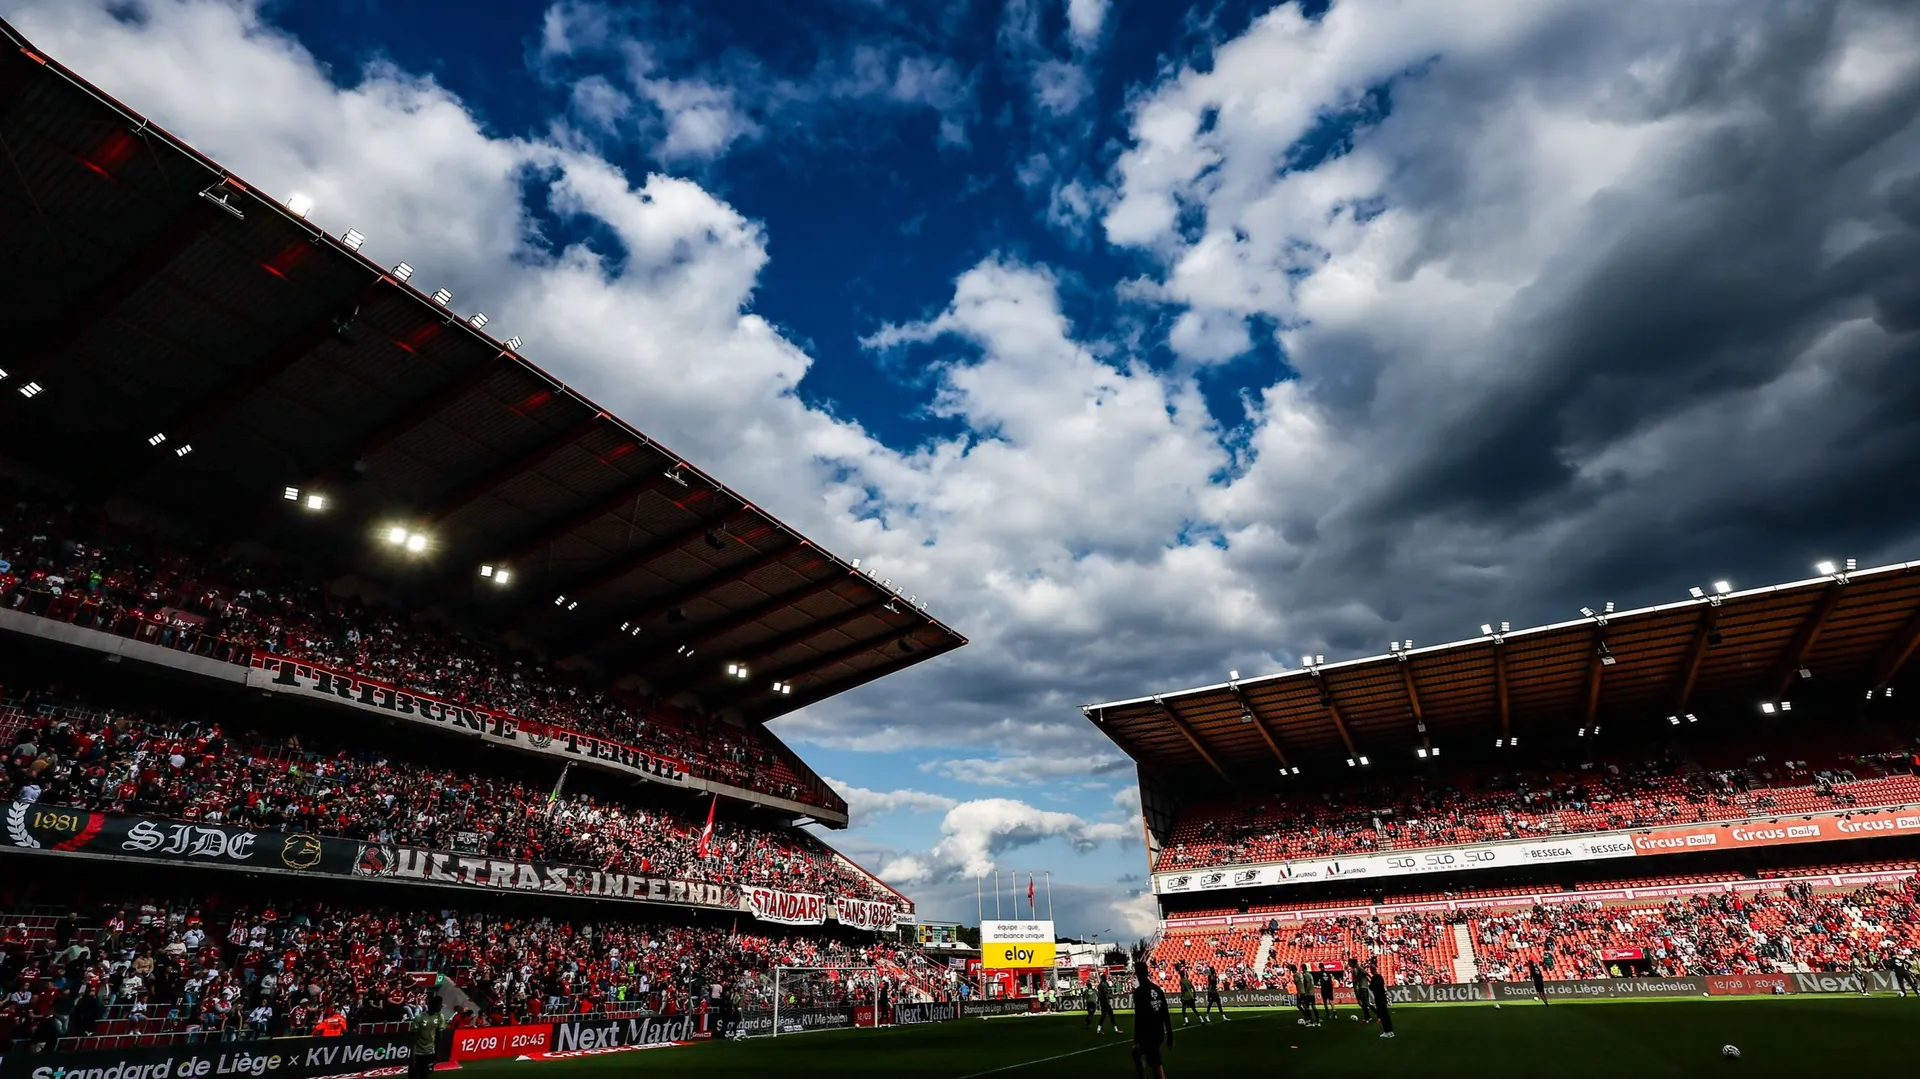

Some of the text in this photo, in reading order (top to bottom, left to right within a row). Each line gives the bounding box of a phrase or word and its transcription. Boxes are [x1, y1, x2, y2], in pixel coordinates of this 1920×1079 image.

[264, 657, 684, 782] TRIBUNE TERRIL
[33, 812, 78, 832] 1981
[1837, 819, 1895, 833] Circus
[121, 820, 258, 860] SIDE
[1732, 826, 1816, 841] Circus Daily
[1591, 843, 1634, 854] BESSEGA
[1635, 835, 1713, 849] Circus Daily
[1425, 853, 1454, 865] SLD
[1465, 850, 1495, 863] SLD
[1531, 848, 1573, 858] BESSEGA
[1387, 856, 1416, 869] SLD
[396, 849, 569, 892] ULTRAS
[837, 900, 892, 926] FANS 1898
[997, 923, 1018, 931] équipe
[1020, 932, 1045, 940] unique
[1004, 945, 1035, 964] eloy
[1504, 985, 1555, 996] Standrd
[1558, 985, 1572, 994] de
[1574, 984, 1605, 995] Liège
[1616, 982, 1634, 993] KV
[1636, 981, 1697, 992] Mechelen
[1713, 980, 1743, 990] 12/09
[1795, 972, 1863, 992] Next
[1236, 993, 1249, 1003] KV
[1416, 983, 1482, 1002] Match
[761, 1016, 772, 1029] de
[802, 1014, 813, 1026] KV
[894, 1004, 922, 1024] Next
[558, 1015, 695, 1051] Next Match
[461, 1033, 545, 1053] 12/09 20:45
[32, 1057, 174, 1079] Standard
[178, 1056, 211, 1078] de
[216, 1052, 282, 1076] Liège
[305, 1046, 340, 1067] KV
